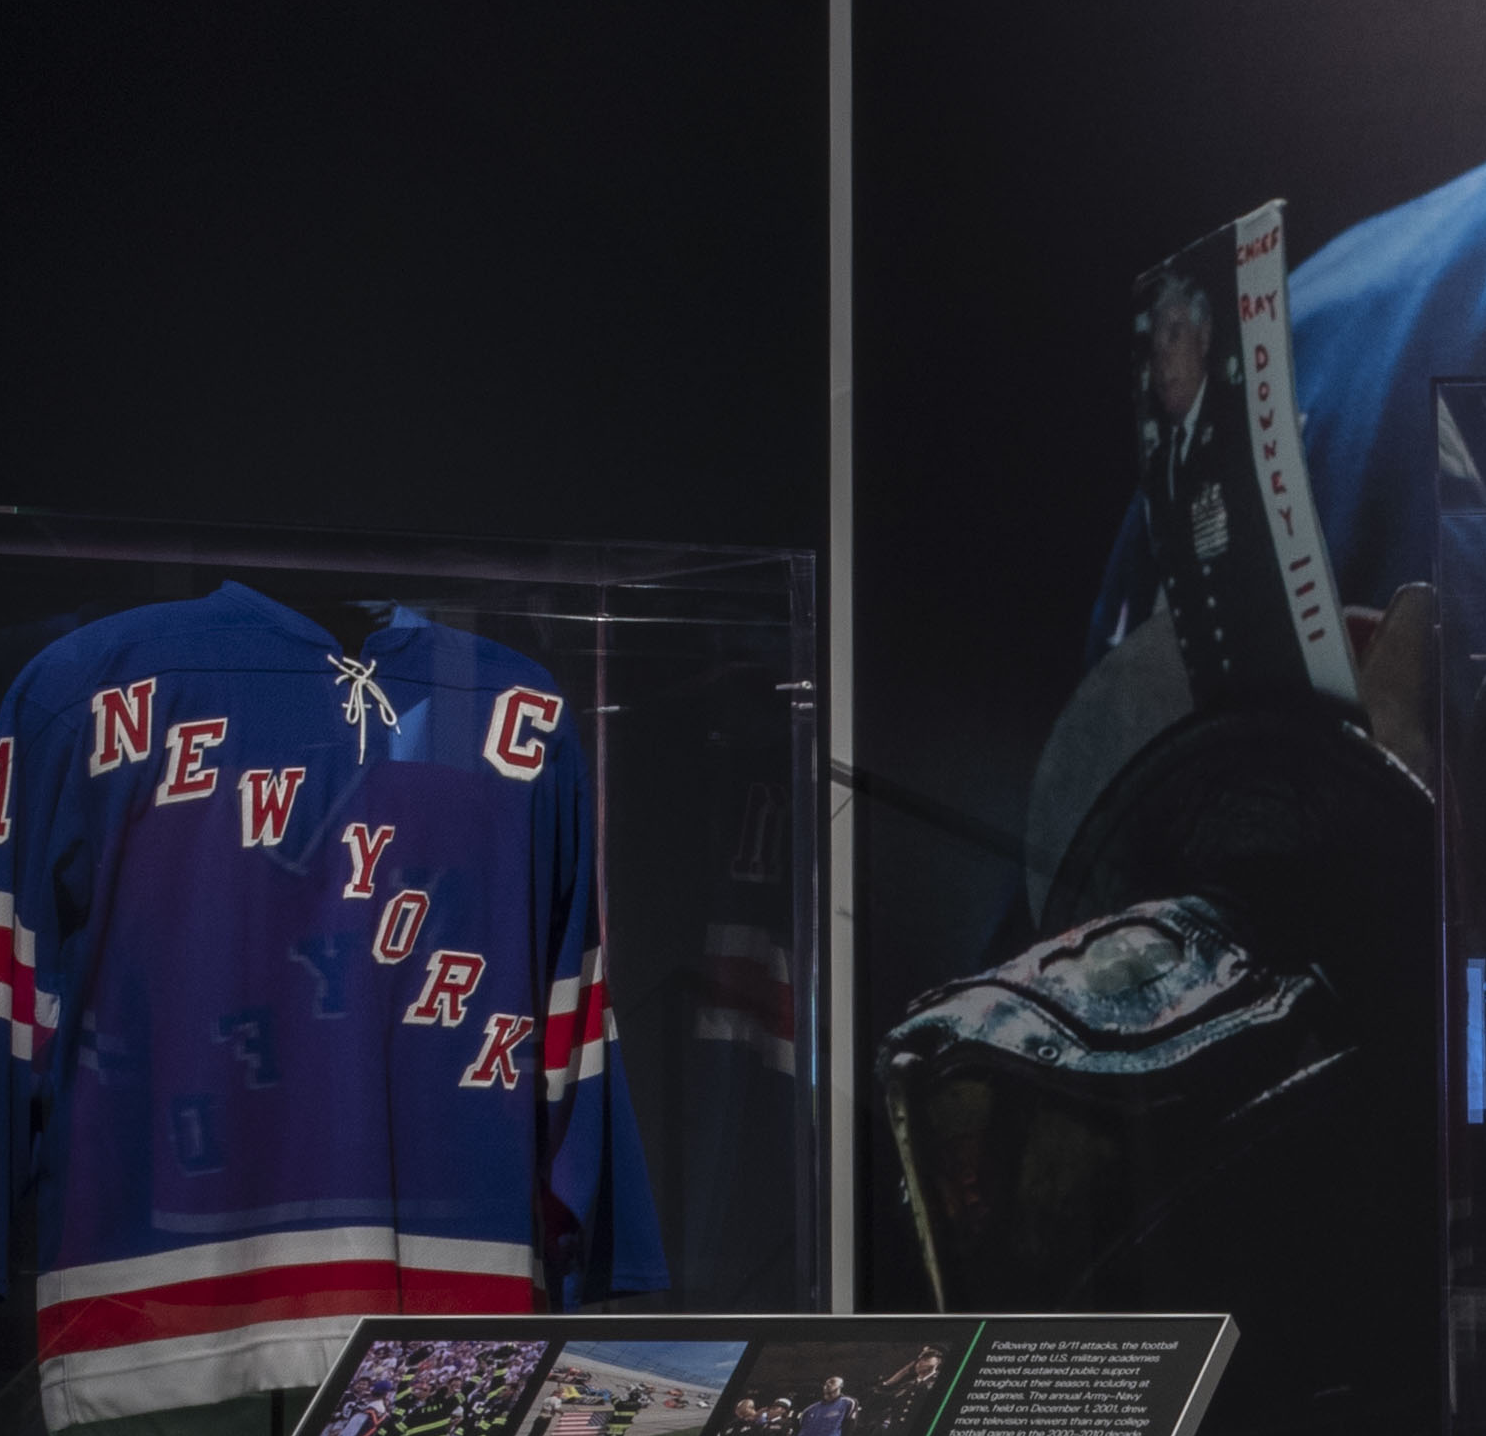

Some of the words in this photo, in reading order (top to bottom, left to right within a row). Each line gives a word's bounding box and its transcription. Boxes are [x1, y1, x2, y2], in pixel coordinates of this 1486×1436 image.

[1239, 289, 1278, 322] RAY
[1254, 343, 1294, 538] DOWNEY
[90, 678, 306, 847] NEW
[483, 685, 563, 781] C
[341, 824, 534, 1090] YORK
